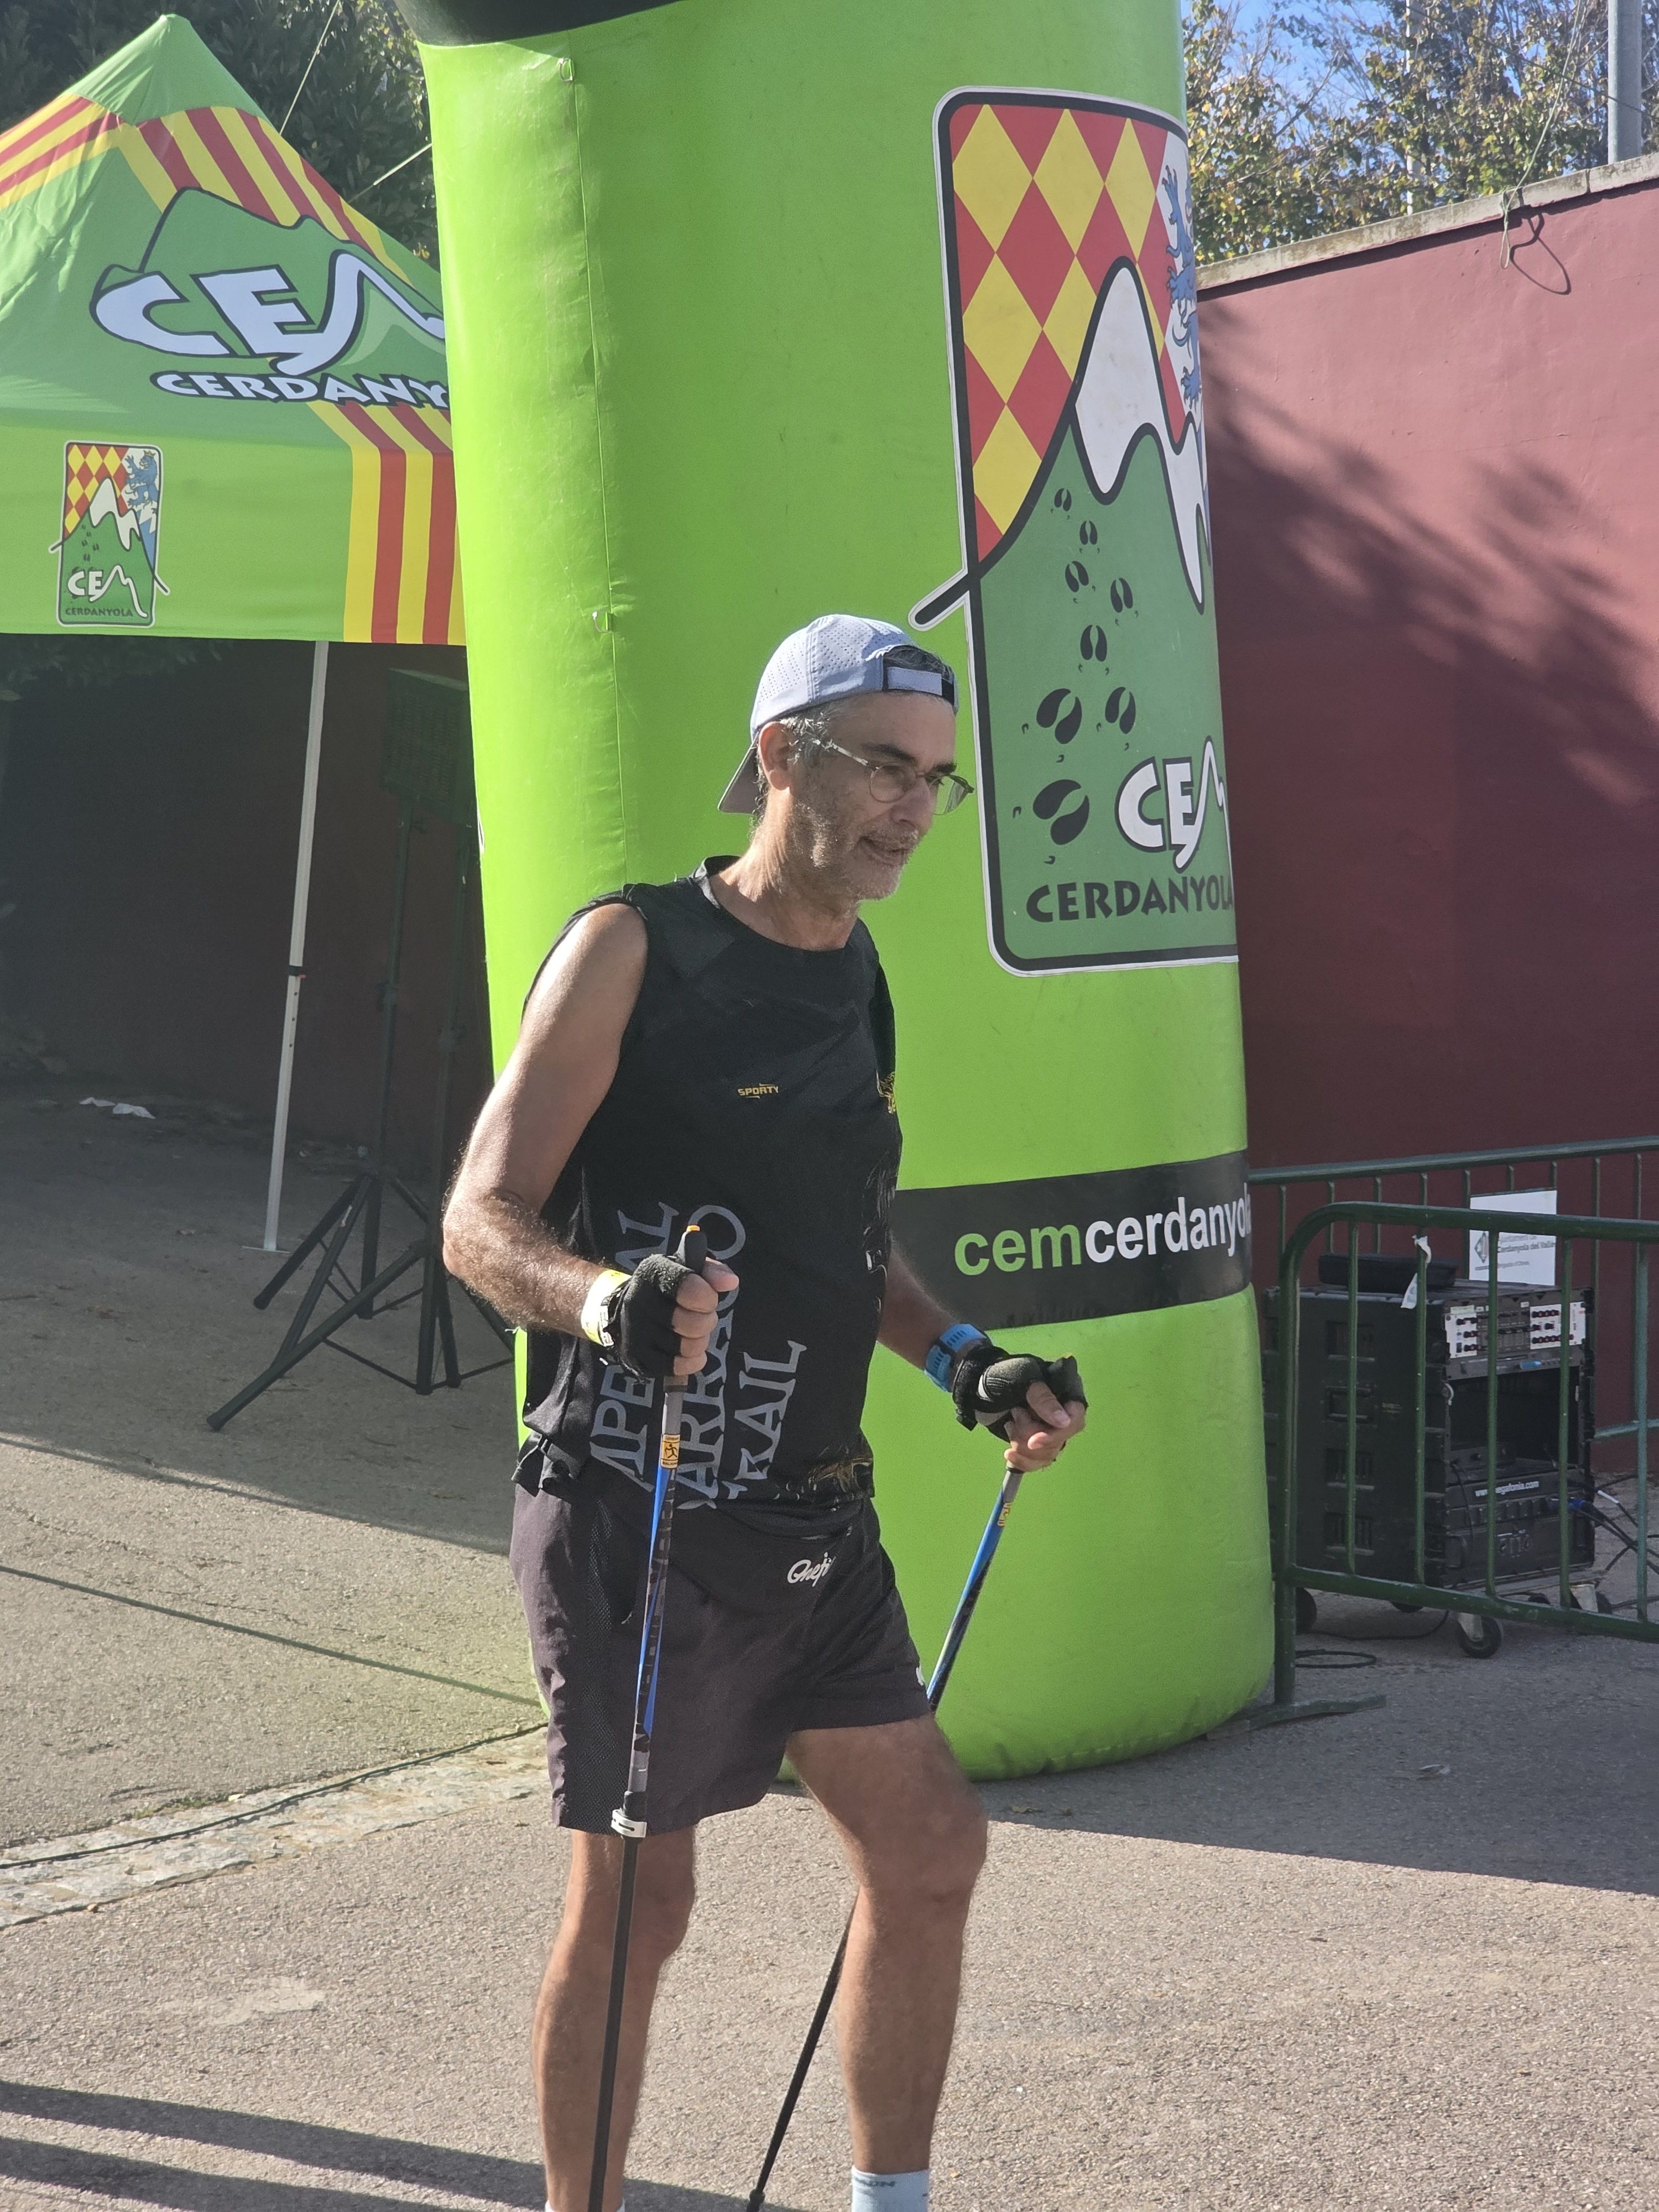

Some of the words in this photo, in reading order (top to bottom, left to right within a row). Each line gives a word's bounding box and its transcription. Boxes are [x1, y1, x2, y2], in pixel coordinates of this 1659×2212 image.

[154, 373, 449, 409] CERDANY
[65, 608, 133, 617] CERDANYOLA
[738, 1084, 779, 1097] SPORTY
